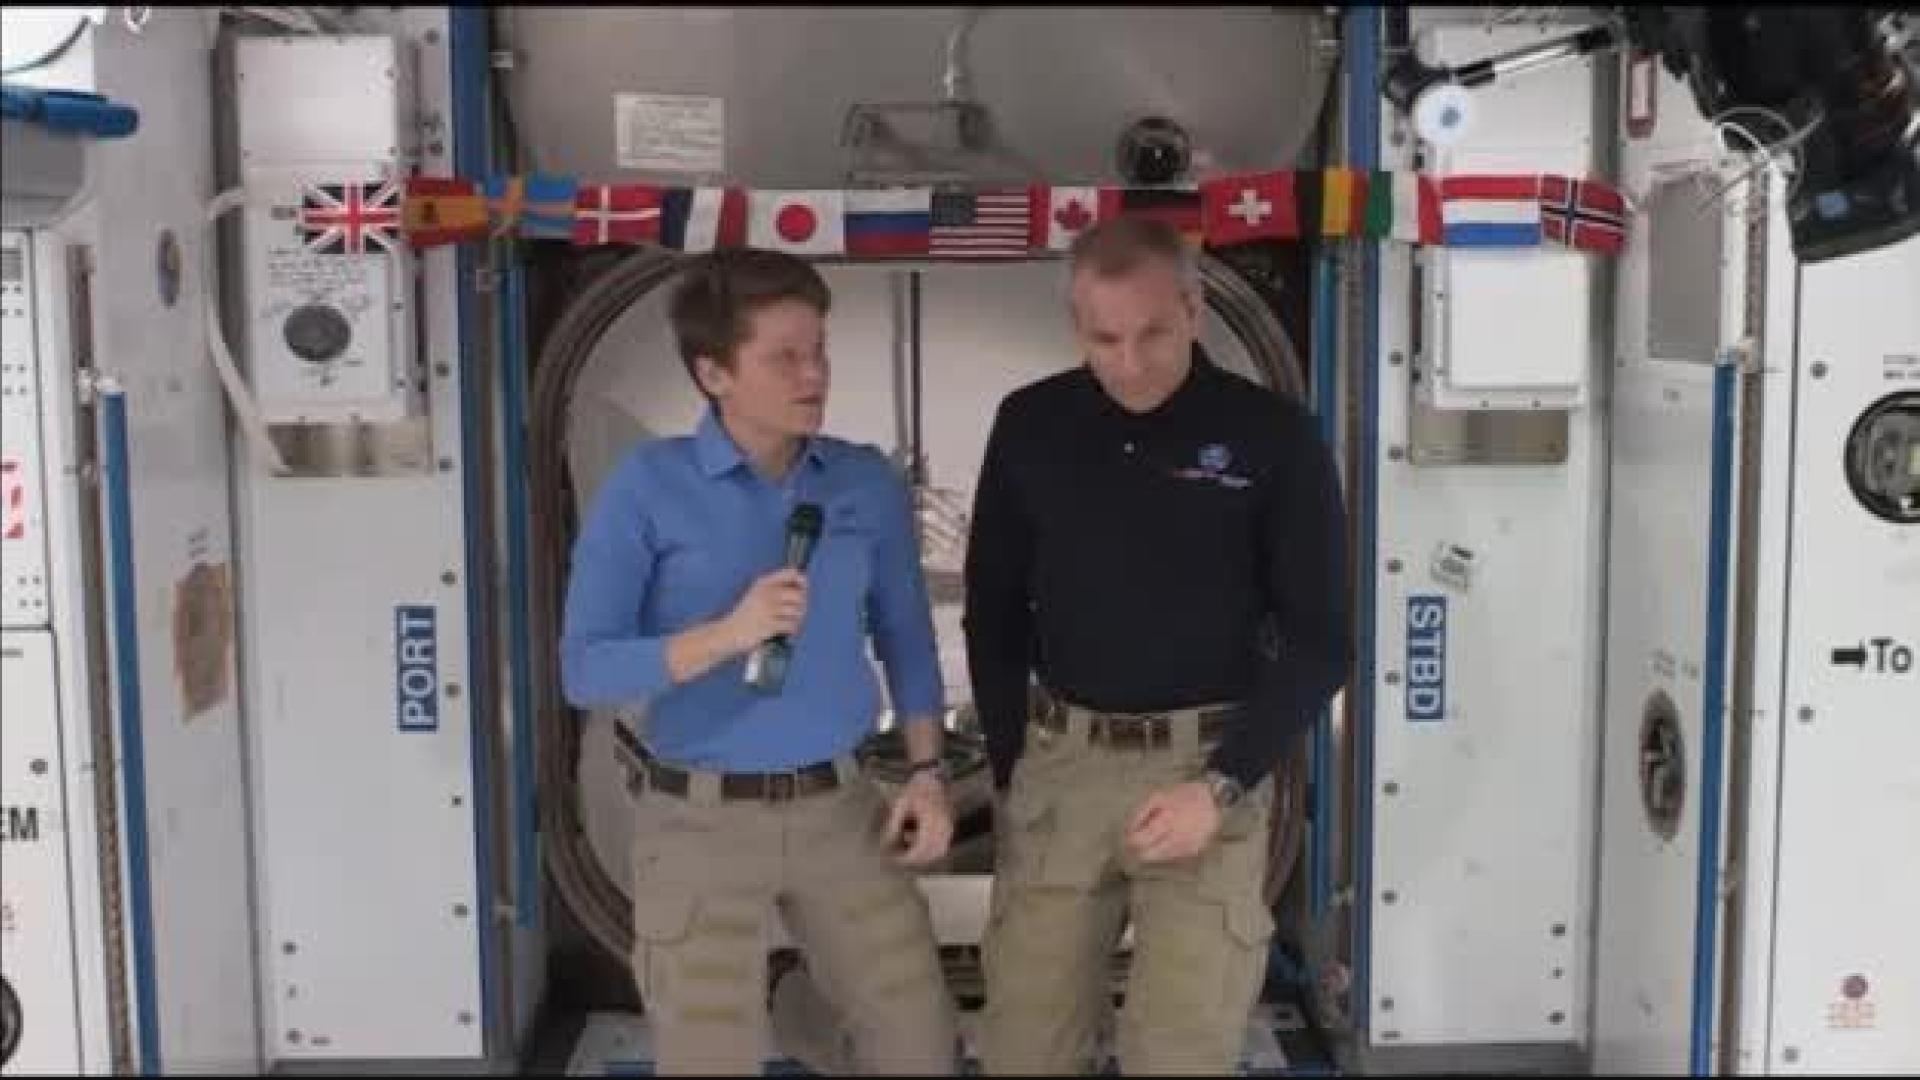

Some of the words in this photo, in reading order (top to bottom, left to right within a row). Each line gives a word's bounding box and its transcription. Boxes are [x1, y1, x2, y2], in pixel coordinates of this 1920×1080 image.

[401, 610, 435, 725] PORT
[1408, 604, 1442, 714] STBD
[1870, 637, 1913, 674] To
